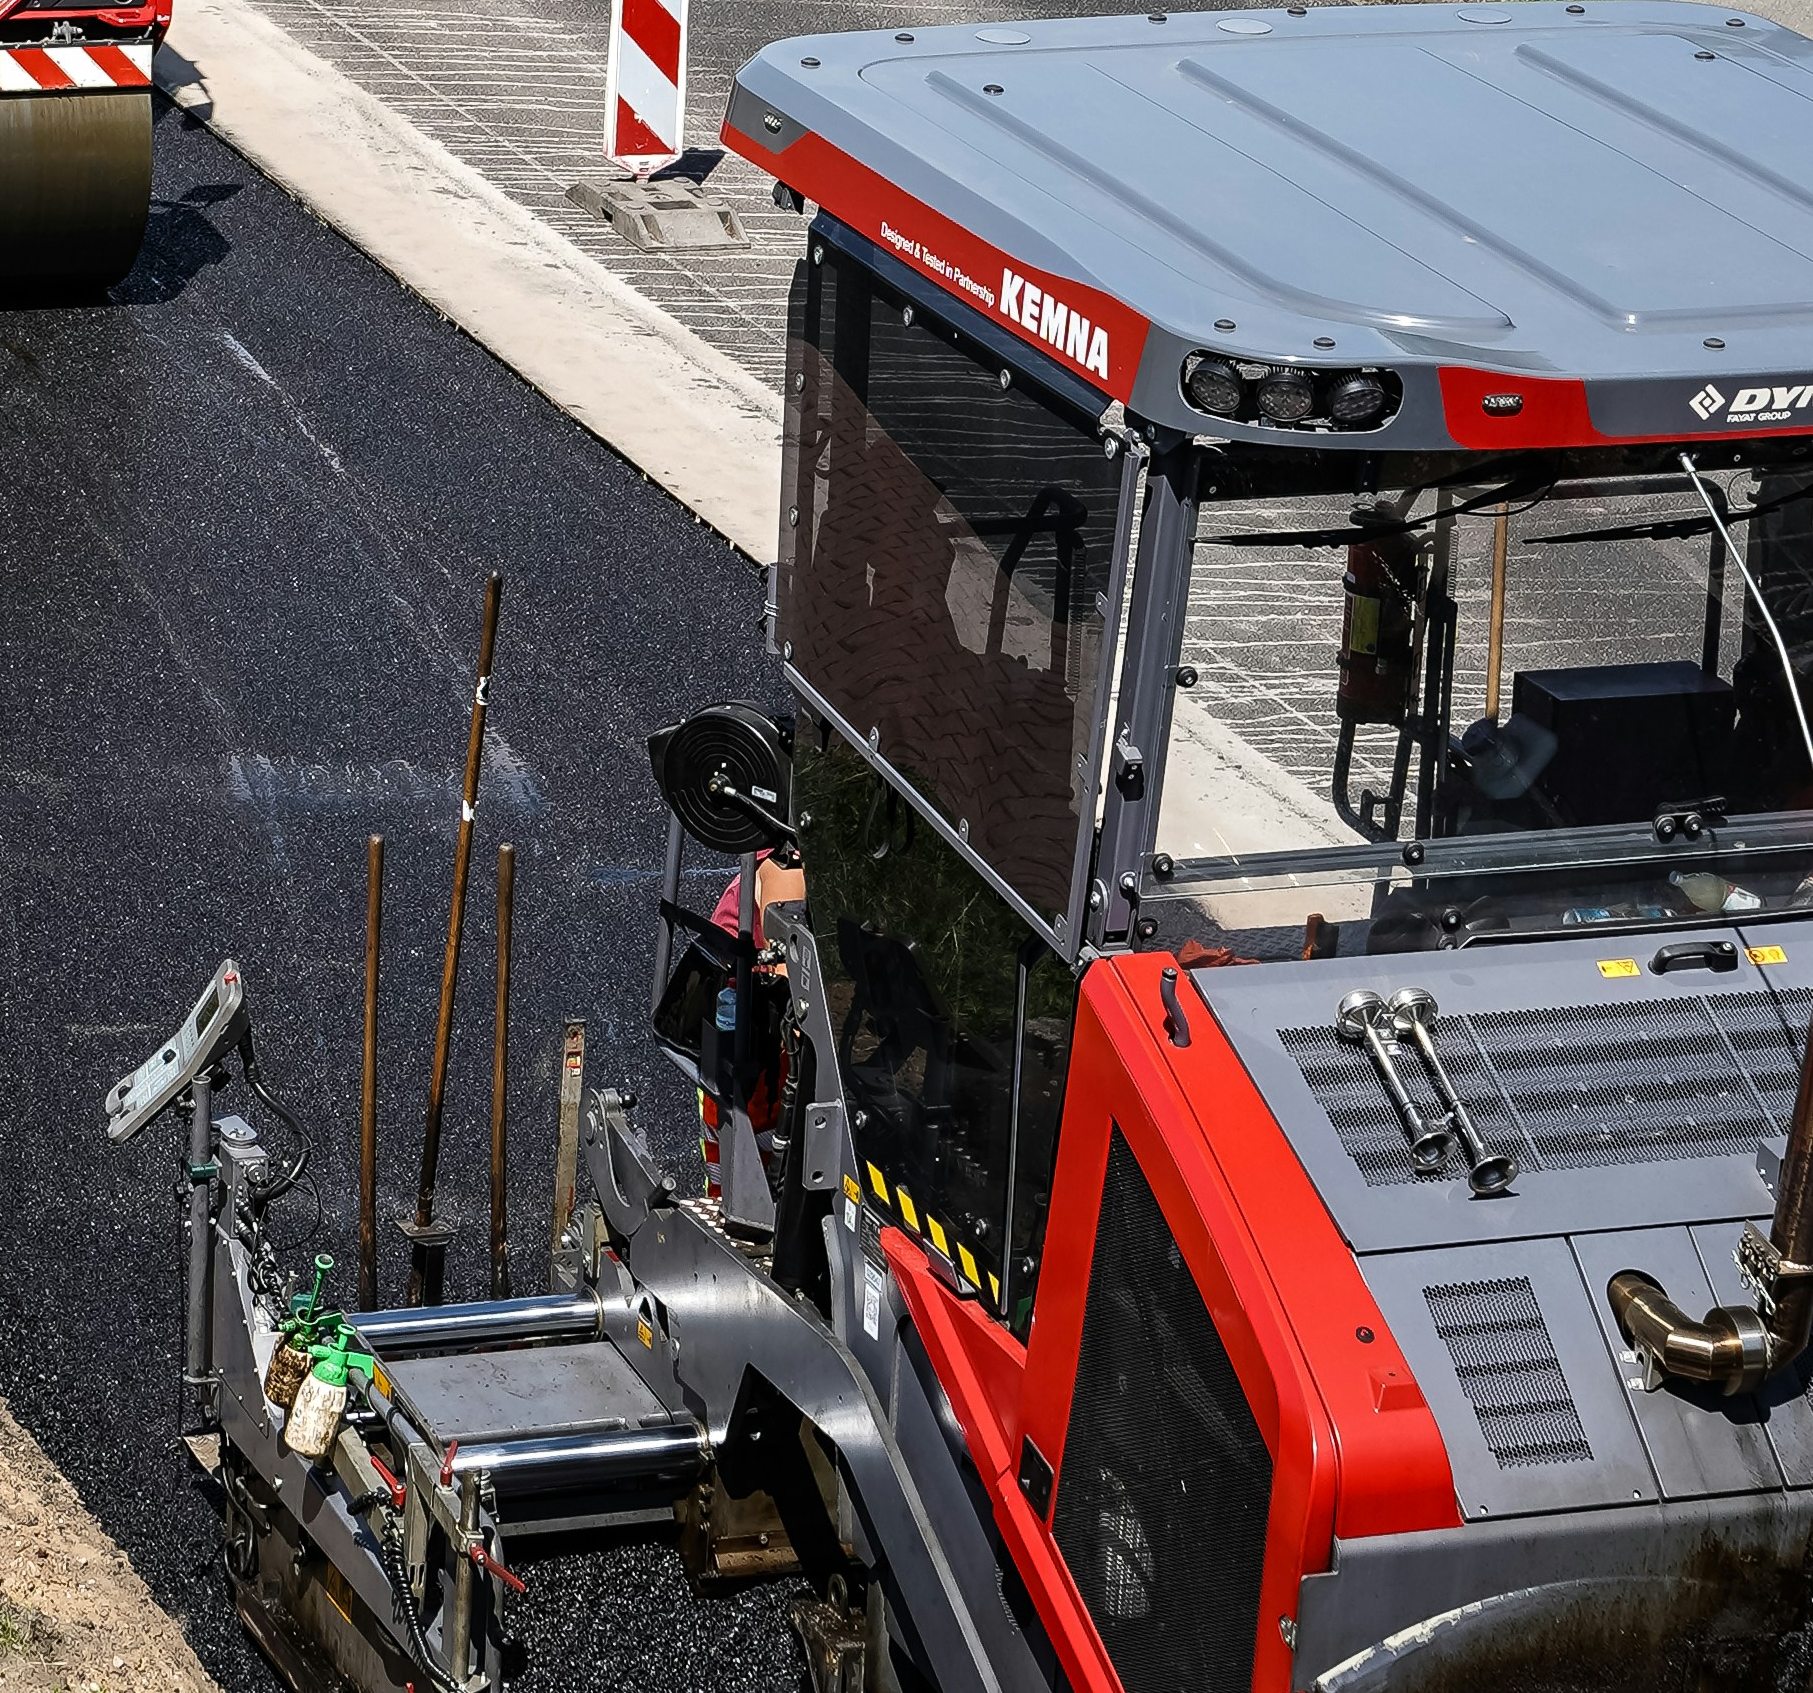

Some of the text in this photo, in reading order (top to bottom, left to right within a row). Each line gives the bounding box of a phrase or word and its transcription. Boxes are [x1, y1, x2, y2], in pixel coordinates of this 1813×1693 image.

[881, 221, 995, 308] Designed & Tested in Partnership
[999, 267, 1109, 381] KEMNA
[1726, 411, 1792, 423] FAYAT GROUP
